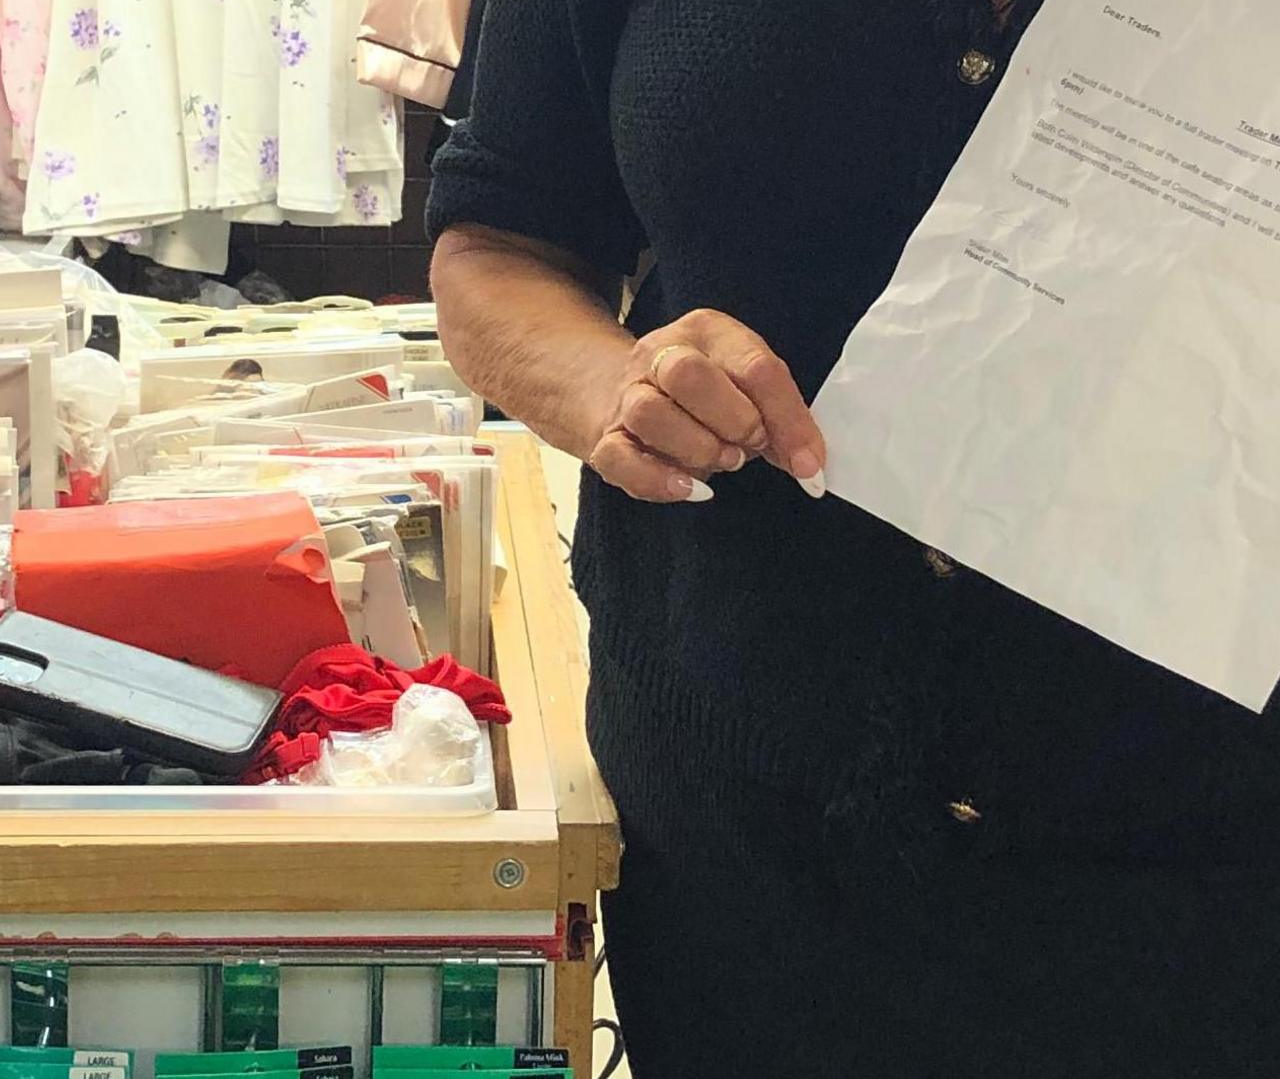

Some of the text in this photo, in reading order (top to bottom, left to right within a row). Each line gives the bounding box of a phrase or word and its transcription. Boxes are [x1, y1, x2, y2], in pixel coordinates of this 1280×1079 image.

[1102, 4, 1126, 21] Dear
[1059, 76, 1085, 96] 6pm)
[1236, 119, 1268, 141] Trader
[1231, 210, 1251, 226] and
[1256, 222, 1274, 237] will
[962, 247, 984, 262] Head
[990, 261, 1032, 288] Community
[1031, 282, 1066, 305] Services
[87, 1056, 115, 1067] LARGE
